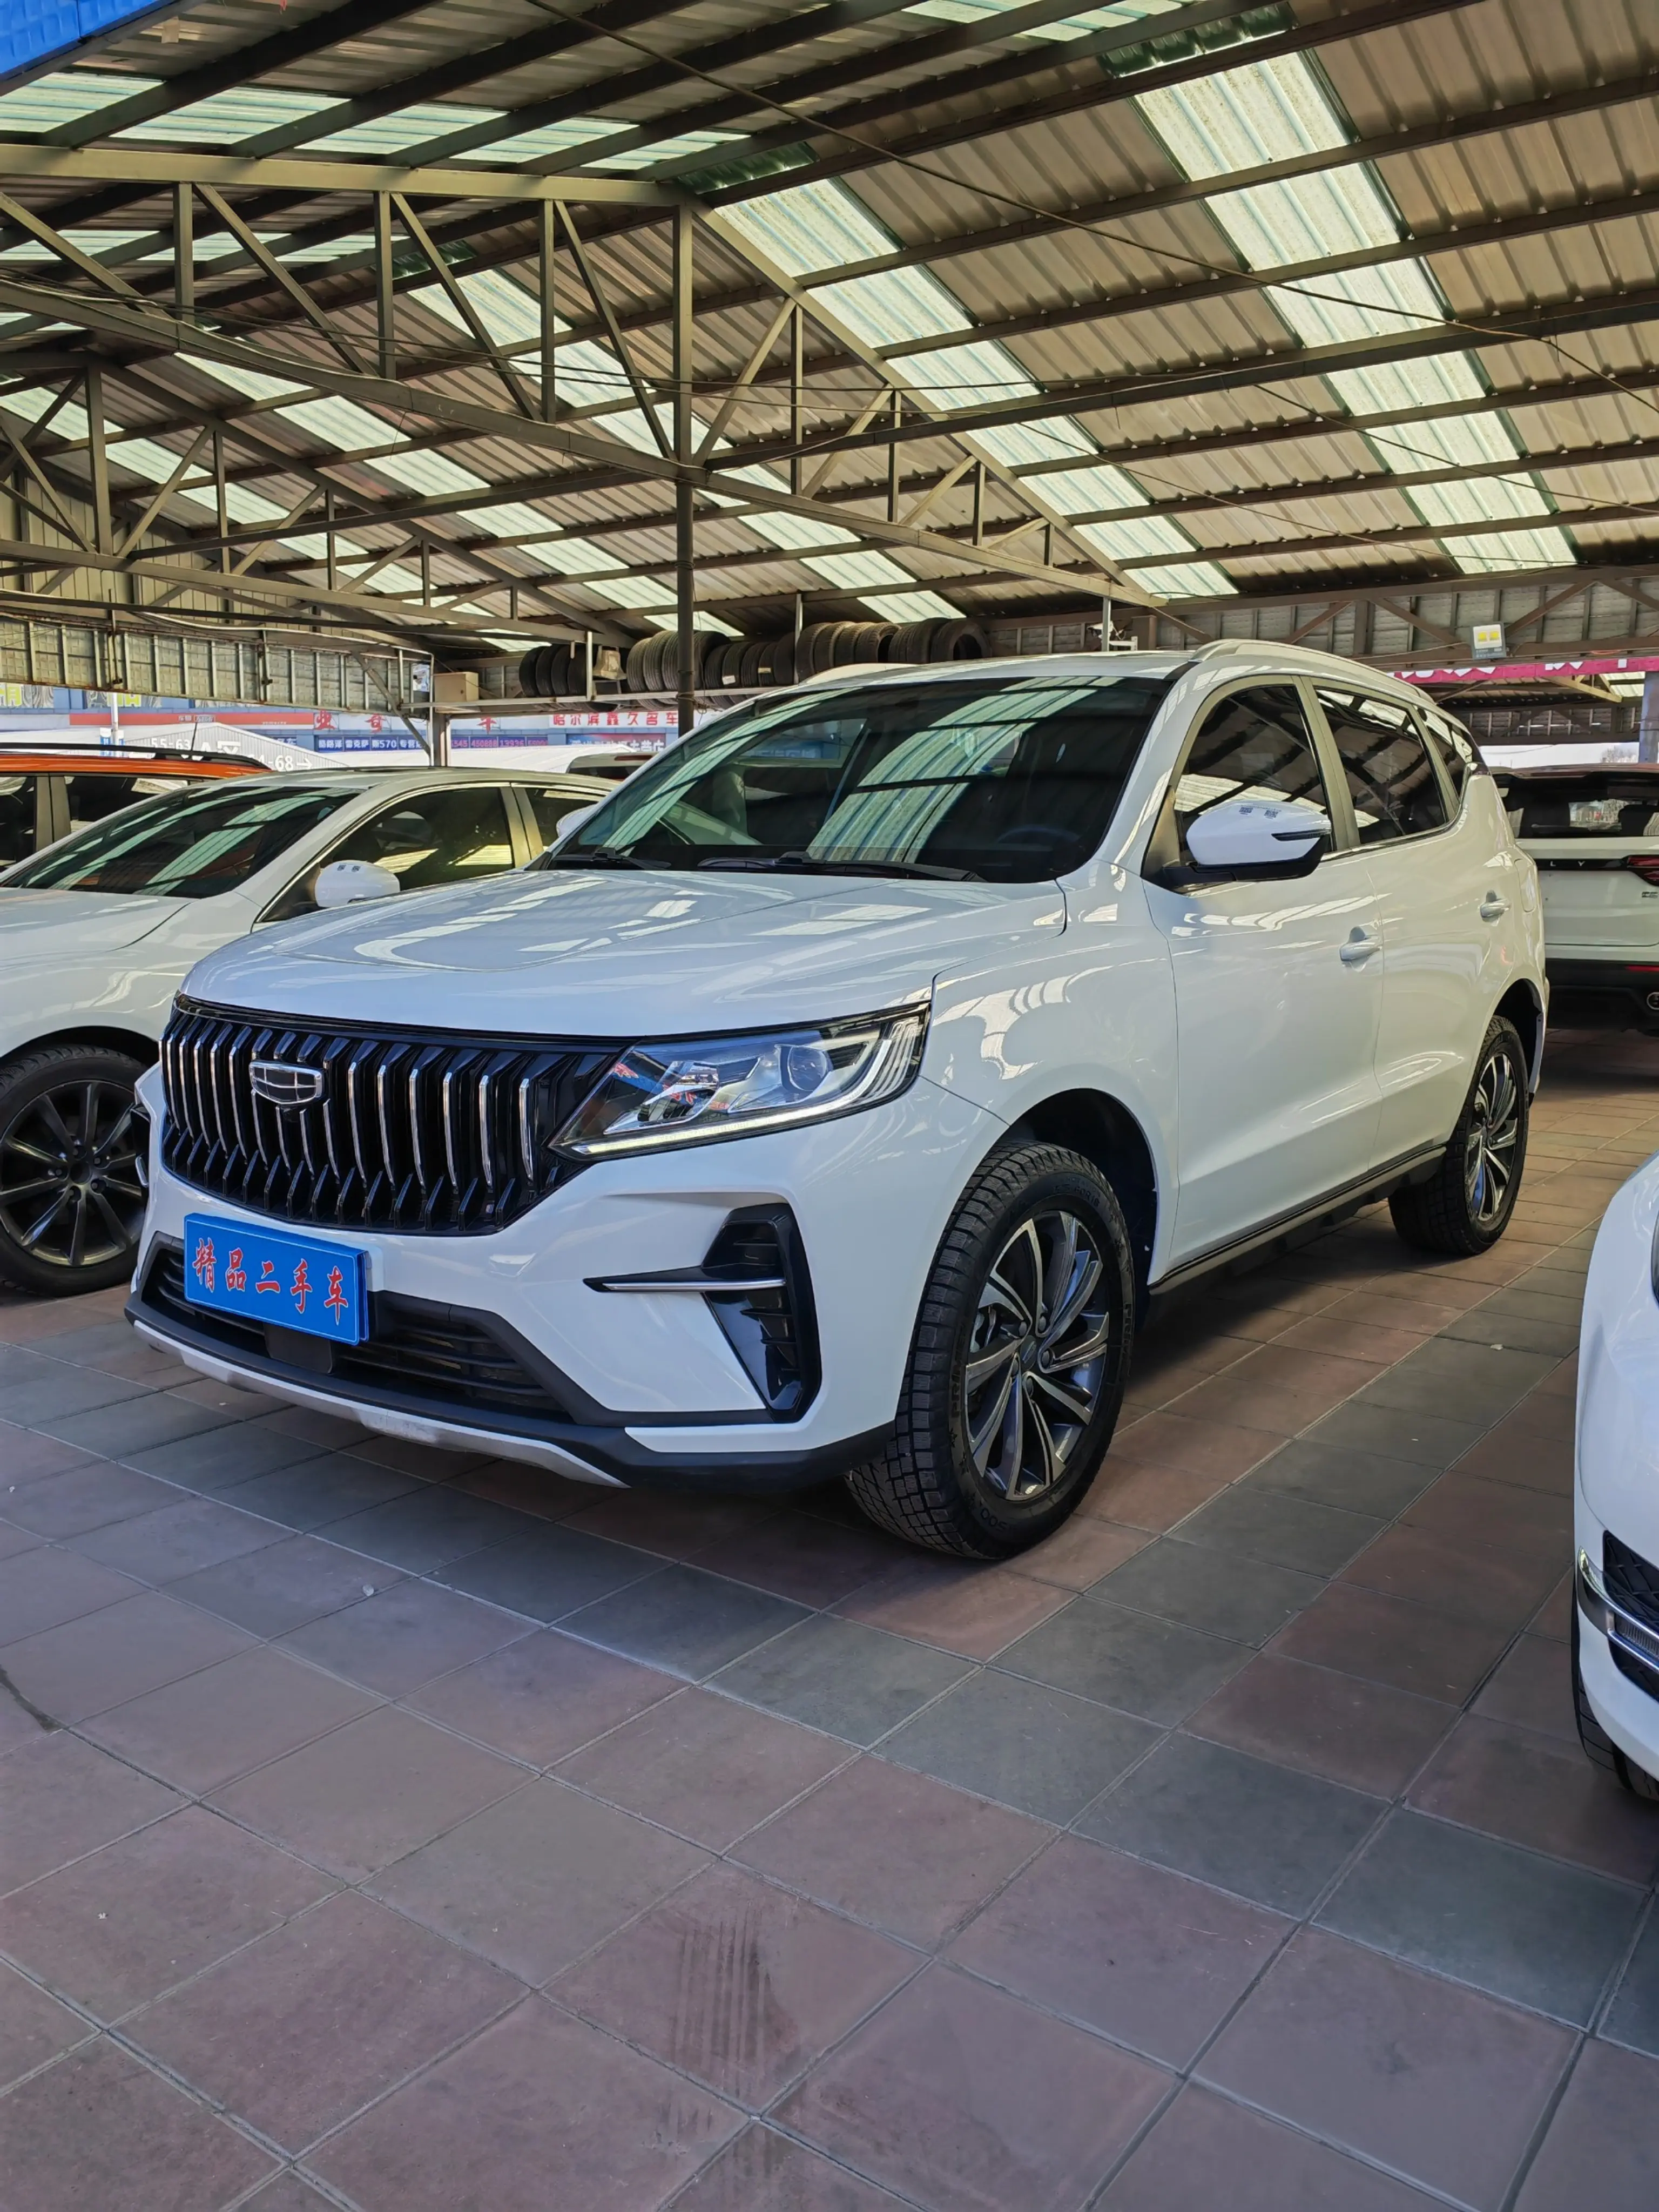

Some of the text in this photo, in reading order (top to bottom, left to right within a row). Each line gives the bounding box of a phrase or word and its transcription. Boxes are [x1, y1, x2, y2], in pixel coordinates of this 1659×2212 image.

[192, 1237, 348, 1326] 精品二手车
